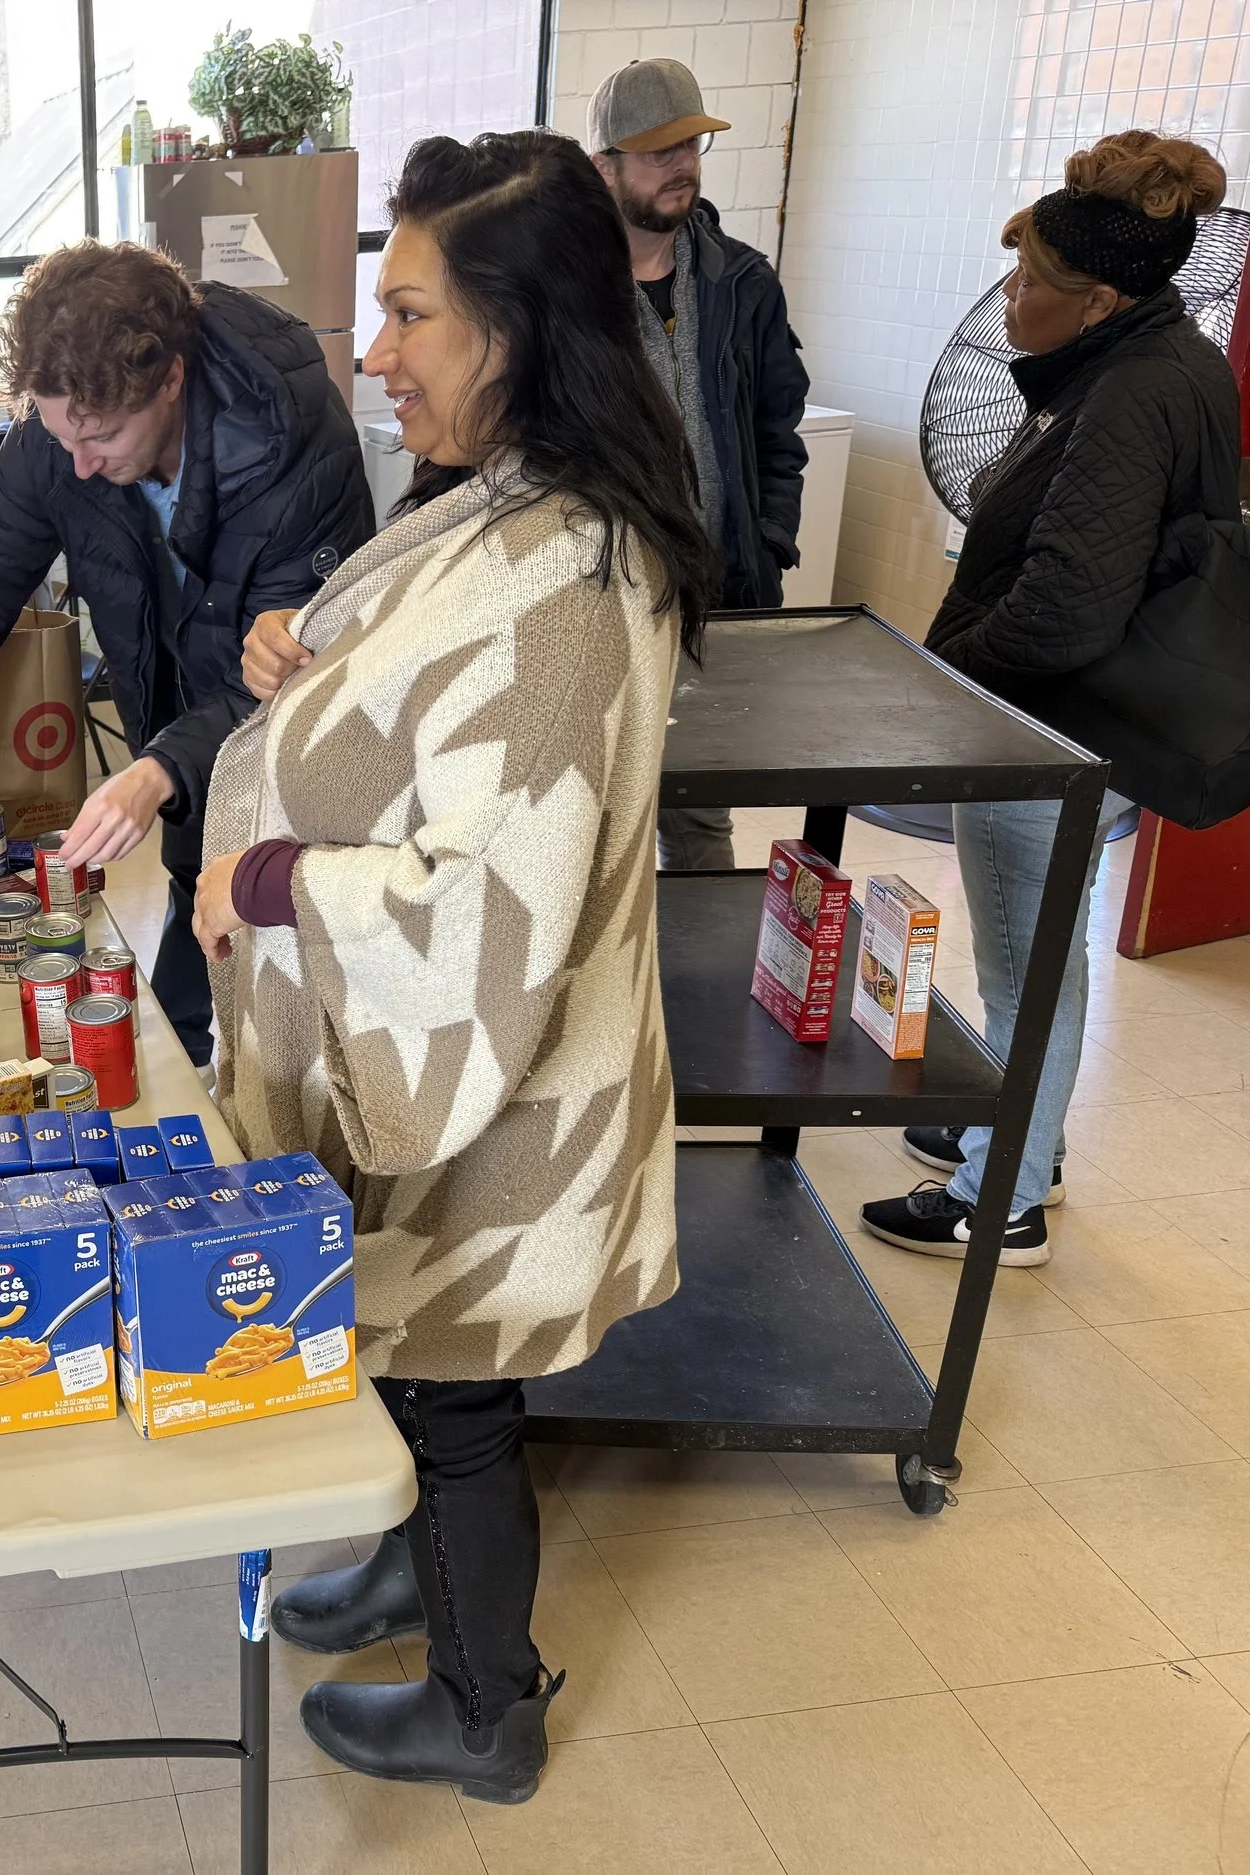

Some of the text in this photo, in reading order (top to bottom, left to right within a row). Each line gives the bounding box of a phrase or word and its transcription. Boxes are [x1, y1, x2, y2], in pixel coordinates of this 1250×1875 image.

[322, 1214, 342, 1242] 5
[192, 1241, 204, 1249] the
[204, 1235, 237, 1247] cheesiest
[237, 1231, 259, 1240] smiles
[260, 1227, 277, 1236] since
[12, 1240, 30, 1249] since
[76, 1232, 97, 1259] 5
[319, 1240, 345, 1255] pack
[235, 1254, 254, 1265] Kraft
[74, 1259, 101, 1272] pack
[221, 1264, 271, 1284] mac &
[11, 1277, 25, 1291] &
[319, 1331, 339, 1341] artificial
[322, 1344, 342, 1353] artificial
[77, 1350, 96, 1358] artificial
[325, 1355, 345, 1365] artificial
[80, 1362, 100, 1371] artificial
[83, 1374, 103, 1382] artificial
[151, 1378, 193, 1395] original
[208, 1401, 234, 1411] MACARONI
[209, 1403, 255, 1418] CHEESE SAUCE MIX
[0, 1416, 12, 1424] MIX
[22, 1412, 32, 1420] NET
[33, 1411, 42, 1419] WT
